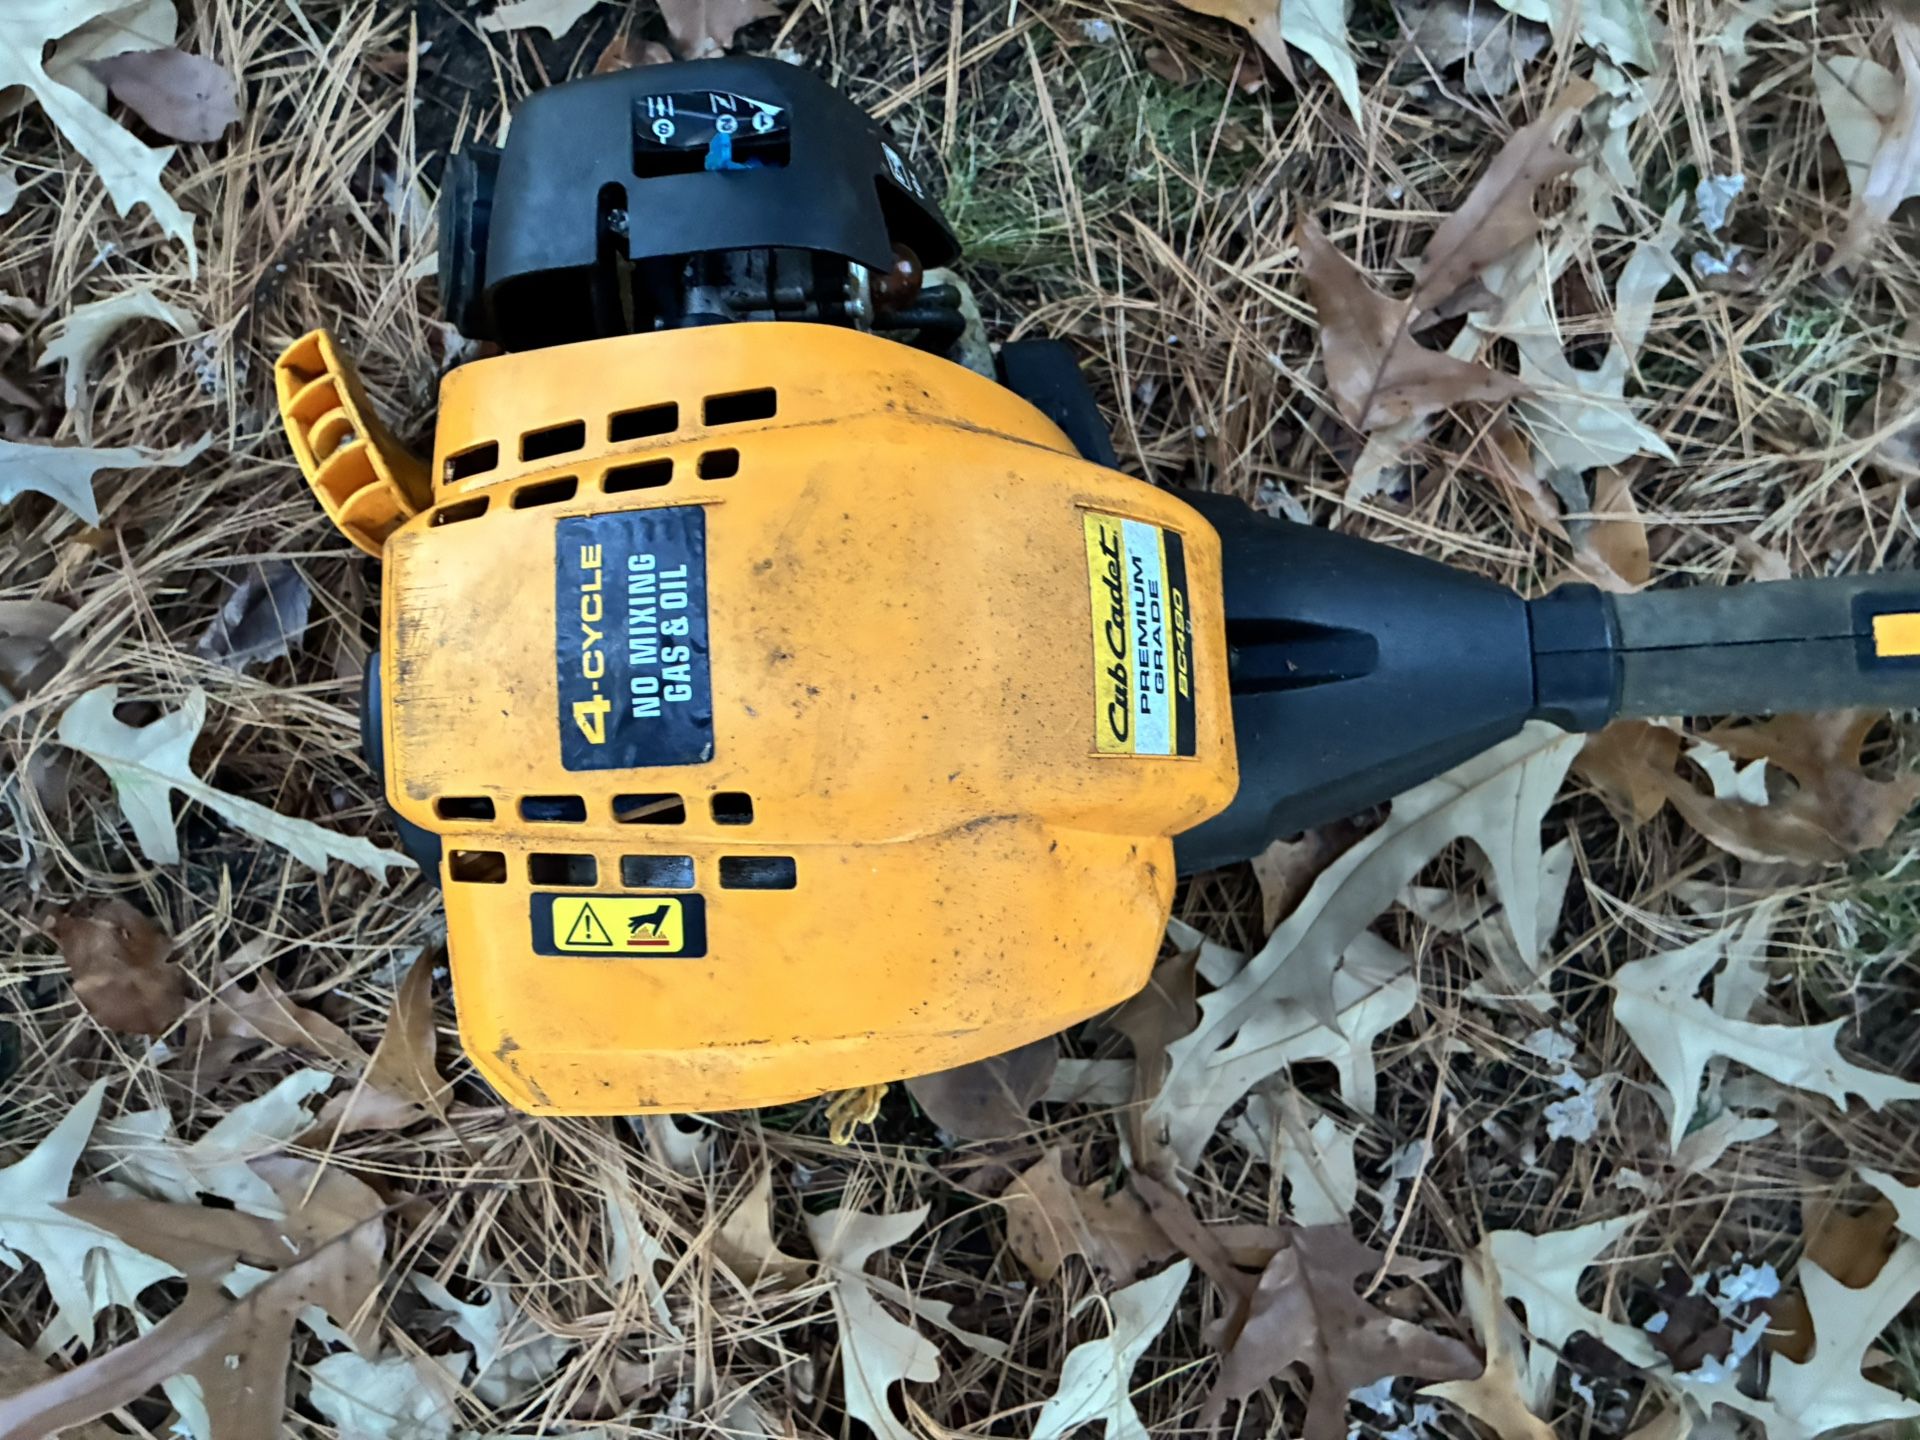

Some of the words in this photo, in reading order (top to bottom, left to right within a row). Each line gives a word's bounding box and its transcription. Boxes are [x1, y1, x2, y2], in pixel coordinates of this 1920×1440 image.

[628, 554, 657, 665] MIXING
[659, 564, 688, 610] OIL
[660, 616, 689, 636] &
[1100, 525, 1127, 660] Cadet
[1131, 556, 1152, 715] PREMIUM
[1148, 580, 1165, 694] GRADE
[1172, 587, 1189, 698] BC490
[573, 544, 611, 744] 4-CYCLE
[631, 676, 661, 718] NO
[661, 645, 692, 702] GAS
[1108, 662, 1128, 742] Cub
